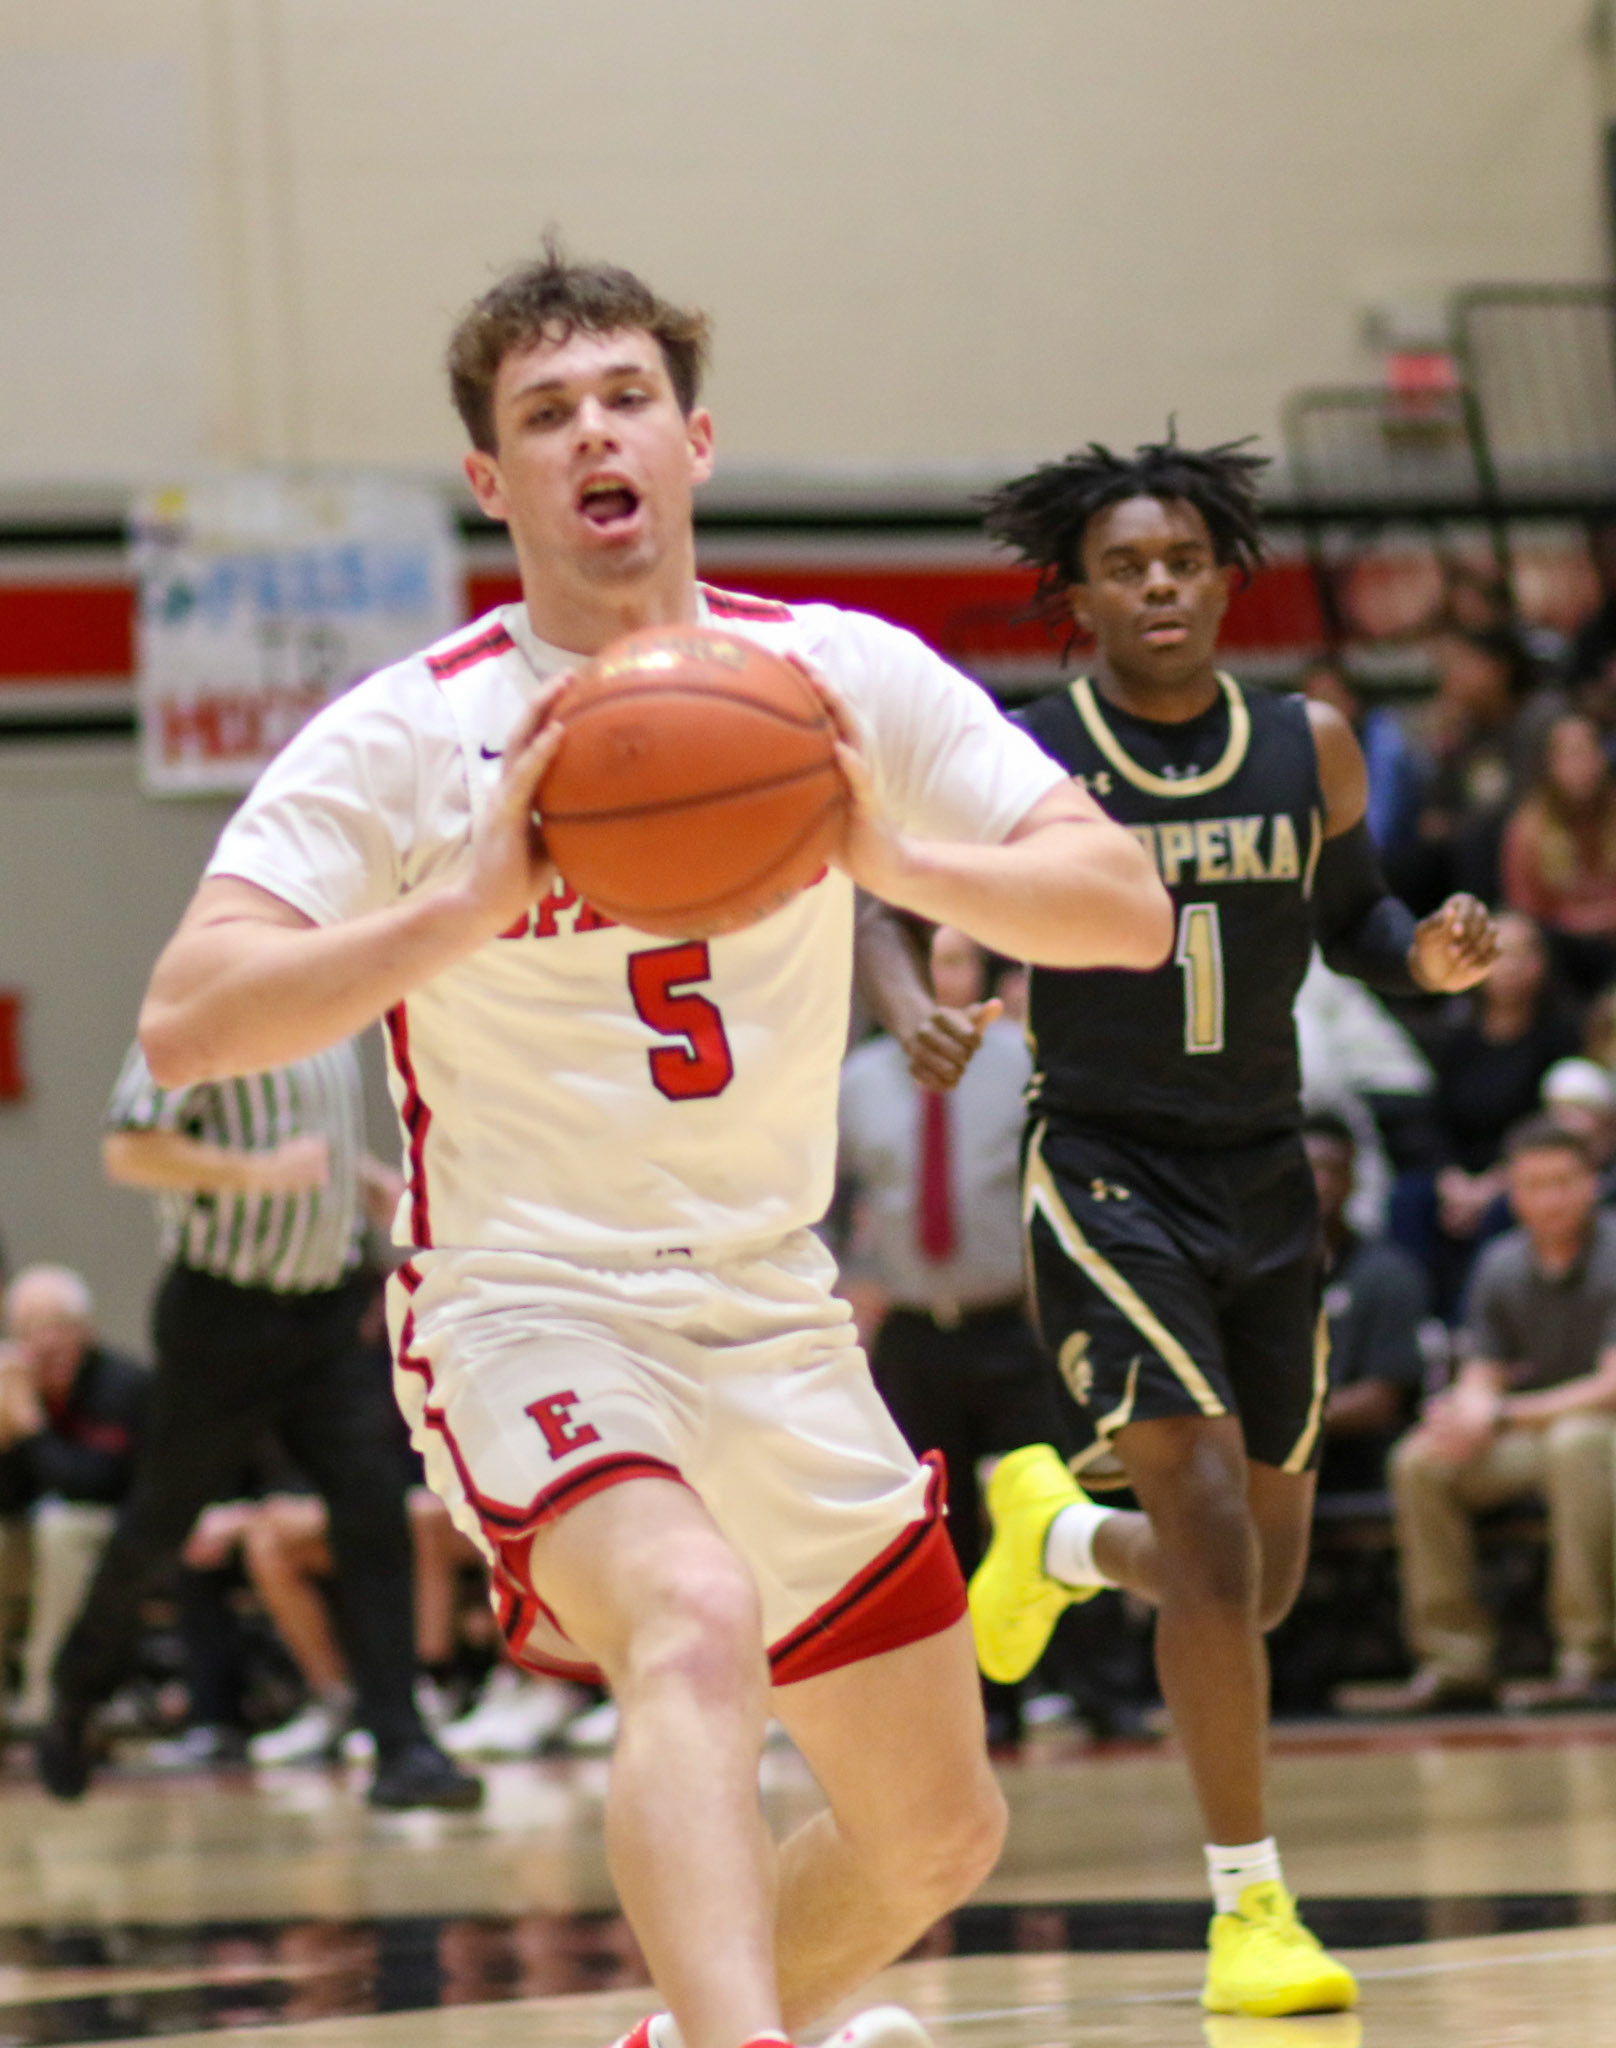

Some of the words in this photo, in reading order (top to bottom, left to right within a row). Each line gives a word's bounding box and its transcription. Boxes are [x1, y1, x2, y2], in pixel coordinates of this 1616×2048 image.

[627, 939, 734, 1101] 5
[1175, 901, 1225, 1055] 1
[524, 1390, 602, 1461] E
